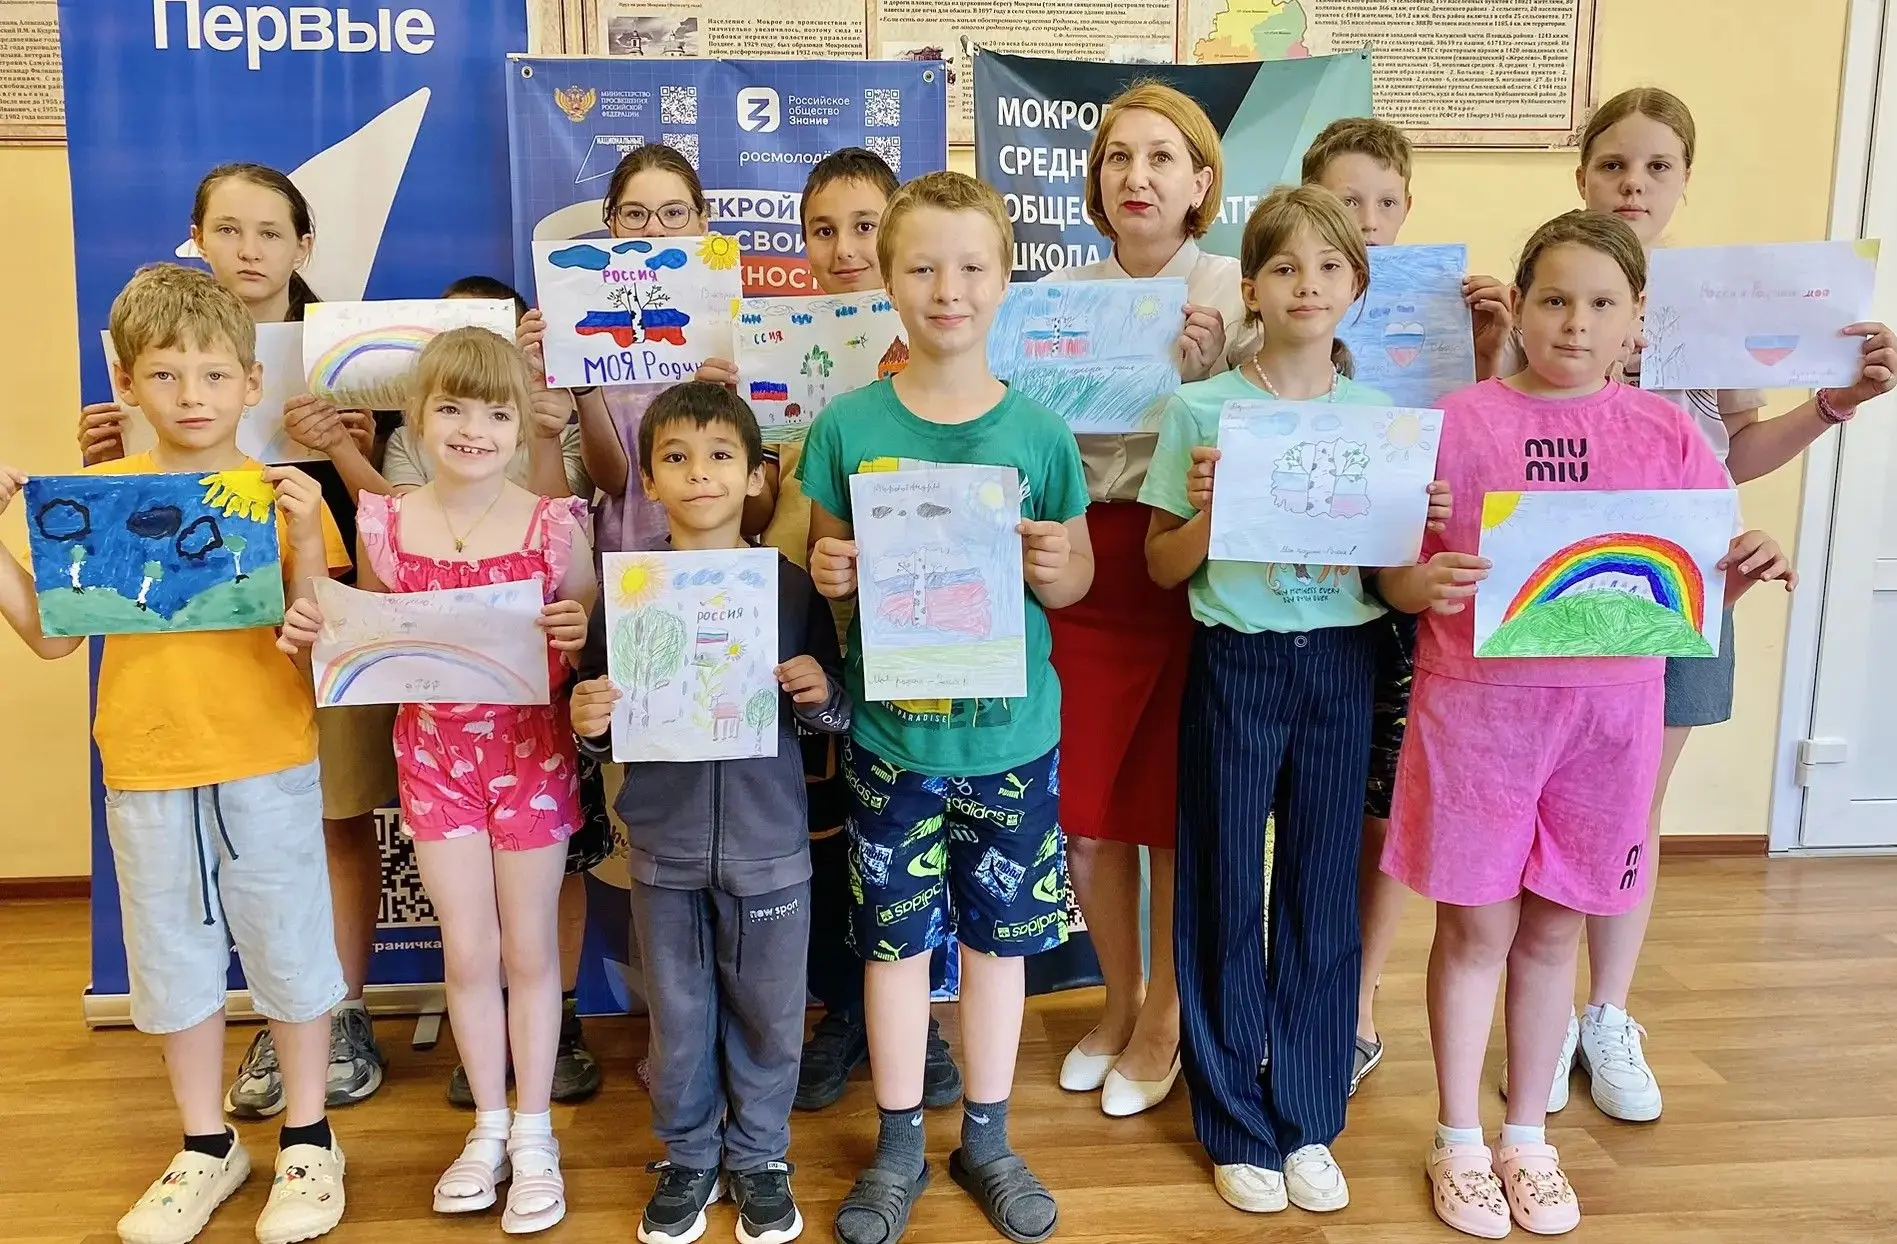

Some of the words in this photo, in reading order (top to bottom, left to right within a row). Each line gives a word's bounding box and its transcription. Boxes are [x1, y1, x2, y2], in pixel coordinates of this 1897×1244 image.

[153, 0, 436, 71] Первые
[788, 95, 850, 106] Российское
[789, 106, 840, 116] общество
[789, 116, 829, 126] Знание
[998, 96, 1109, 130] МОКРО
[739, 150, 832, 166] росмолодё
[999, 145, 1088, 184] СРЕДН
[704, 194, 795, 220] ТКРОЙ
[1012, 242, 1100, 273] ШКОЛА
[602, 269, 658, 283] РОССИЯ
[583, 351, 636, 384] МОЯ
[642, 350, 703, 381] Родин
[897, 709, 947, 724] PARADISE
[951, 797, 1006, 821] adidas
[749, 908, 773, 919] new
[774, 898, 798, 916] sport
[373, 940, 442, 952] раничка
